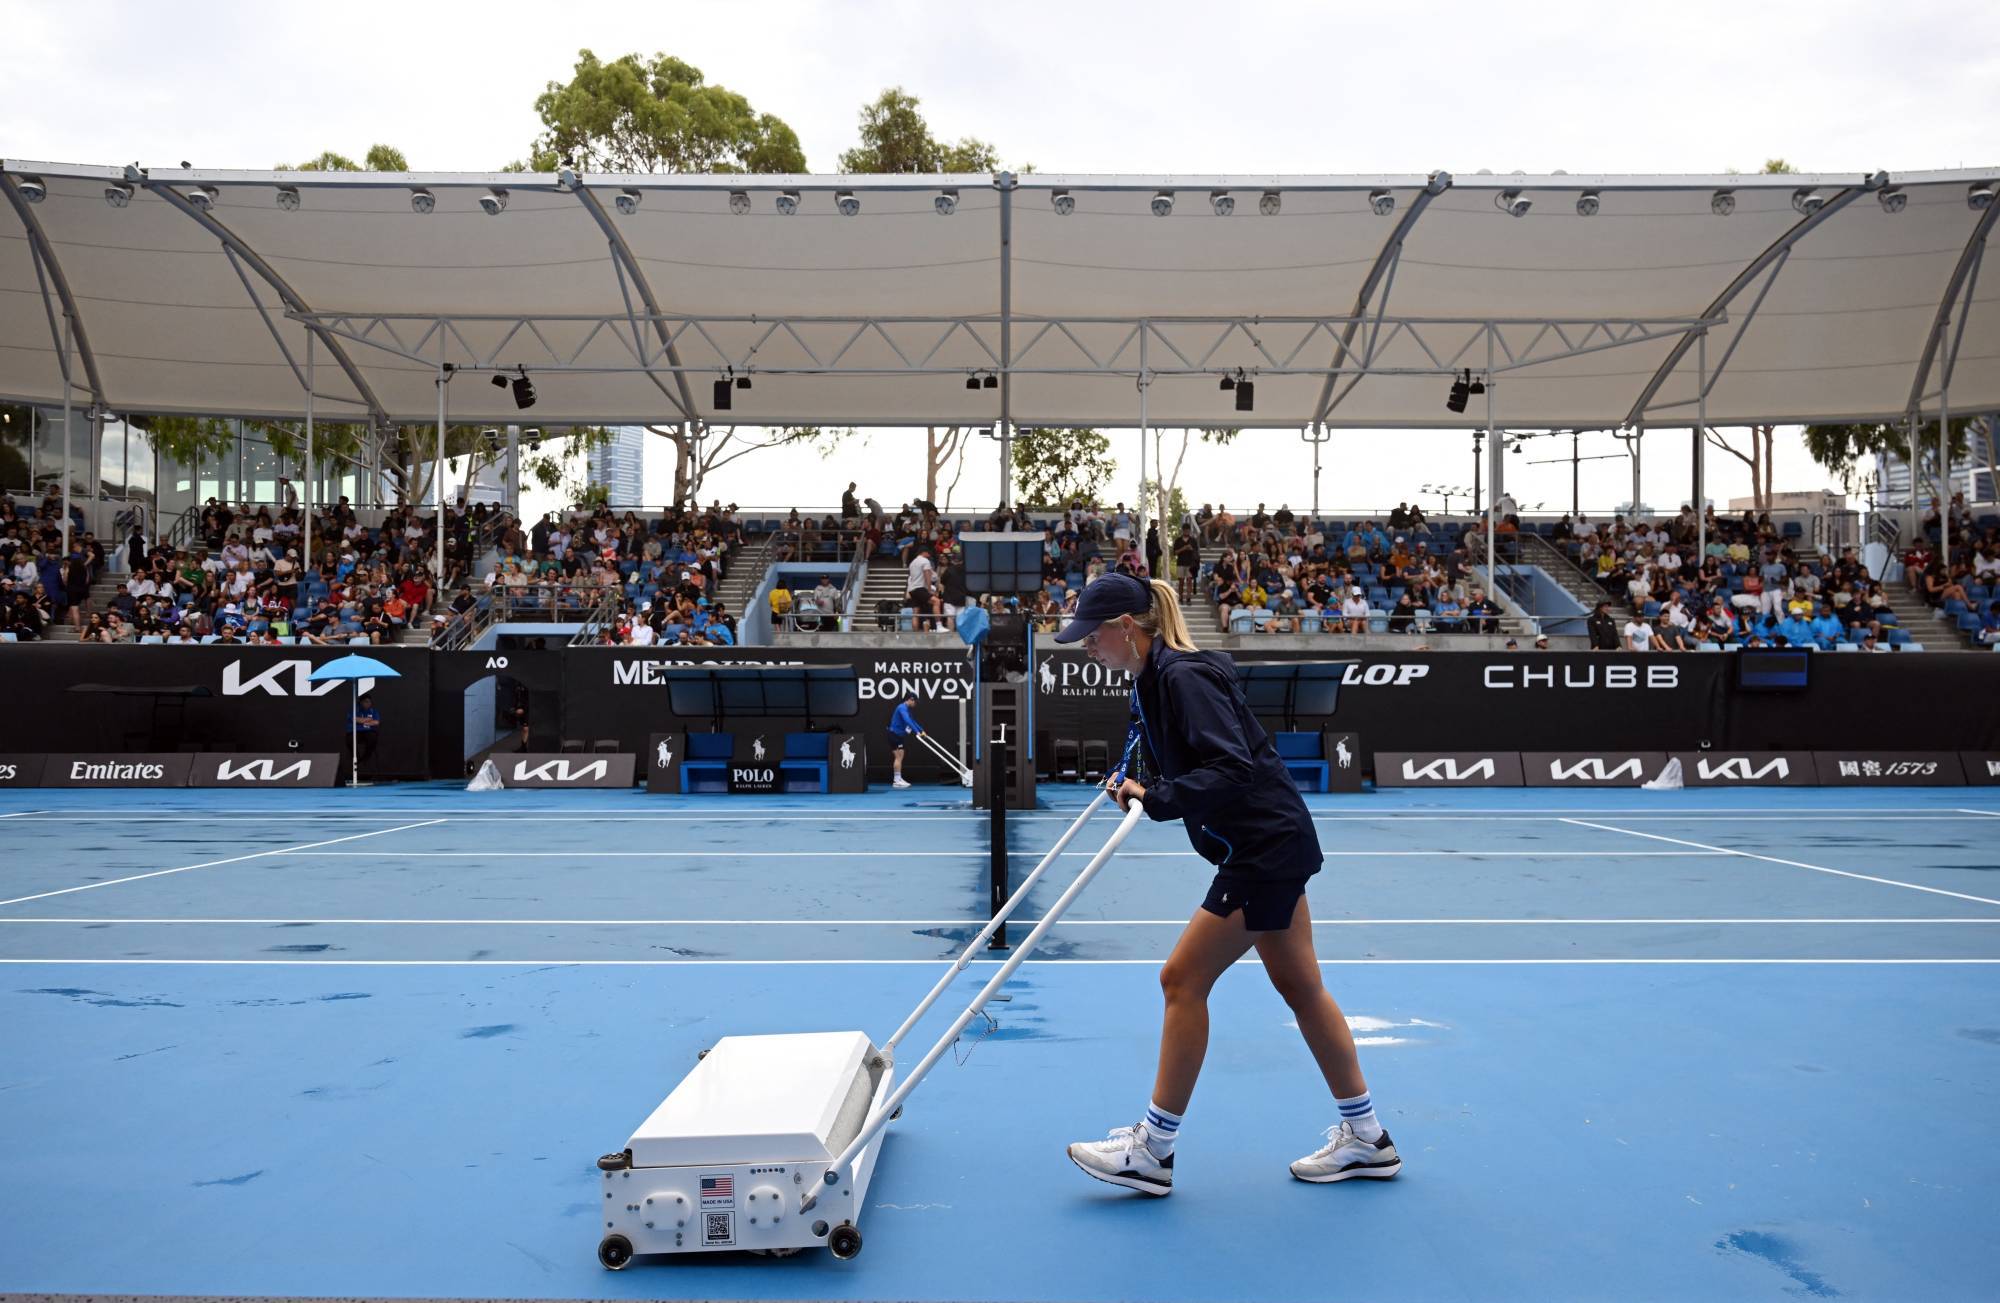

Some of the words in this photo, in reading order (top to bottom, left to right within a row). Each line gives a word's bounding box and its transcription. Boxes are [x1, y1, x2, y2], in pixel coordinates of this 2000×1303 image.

[485, 656, 509, 669] AO
[874, 661, 963, 675] MARRIOTT
[1484, 664, 1679, 689] CHUBB
[1063, 688, 1097, 696] RALPH
[1102, 688, 1133, 697] LAUR
[70, 760, 164, 780] Emirates
[733, 768, 775, 783] POLO
